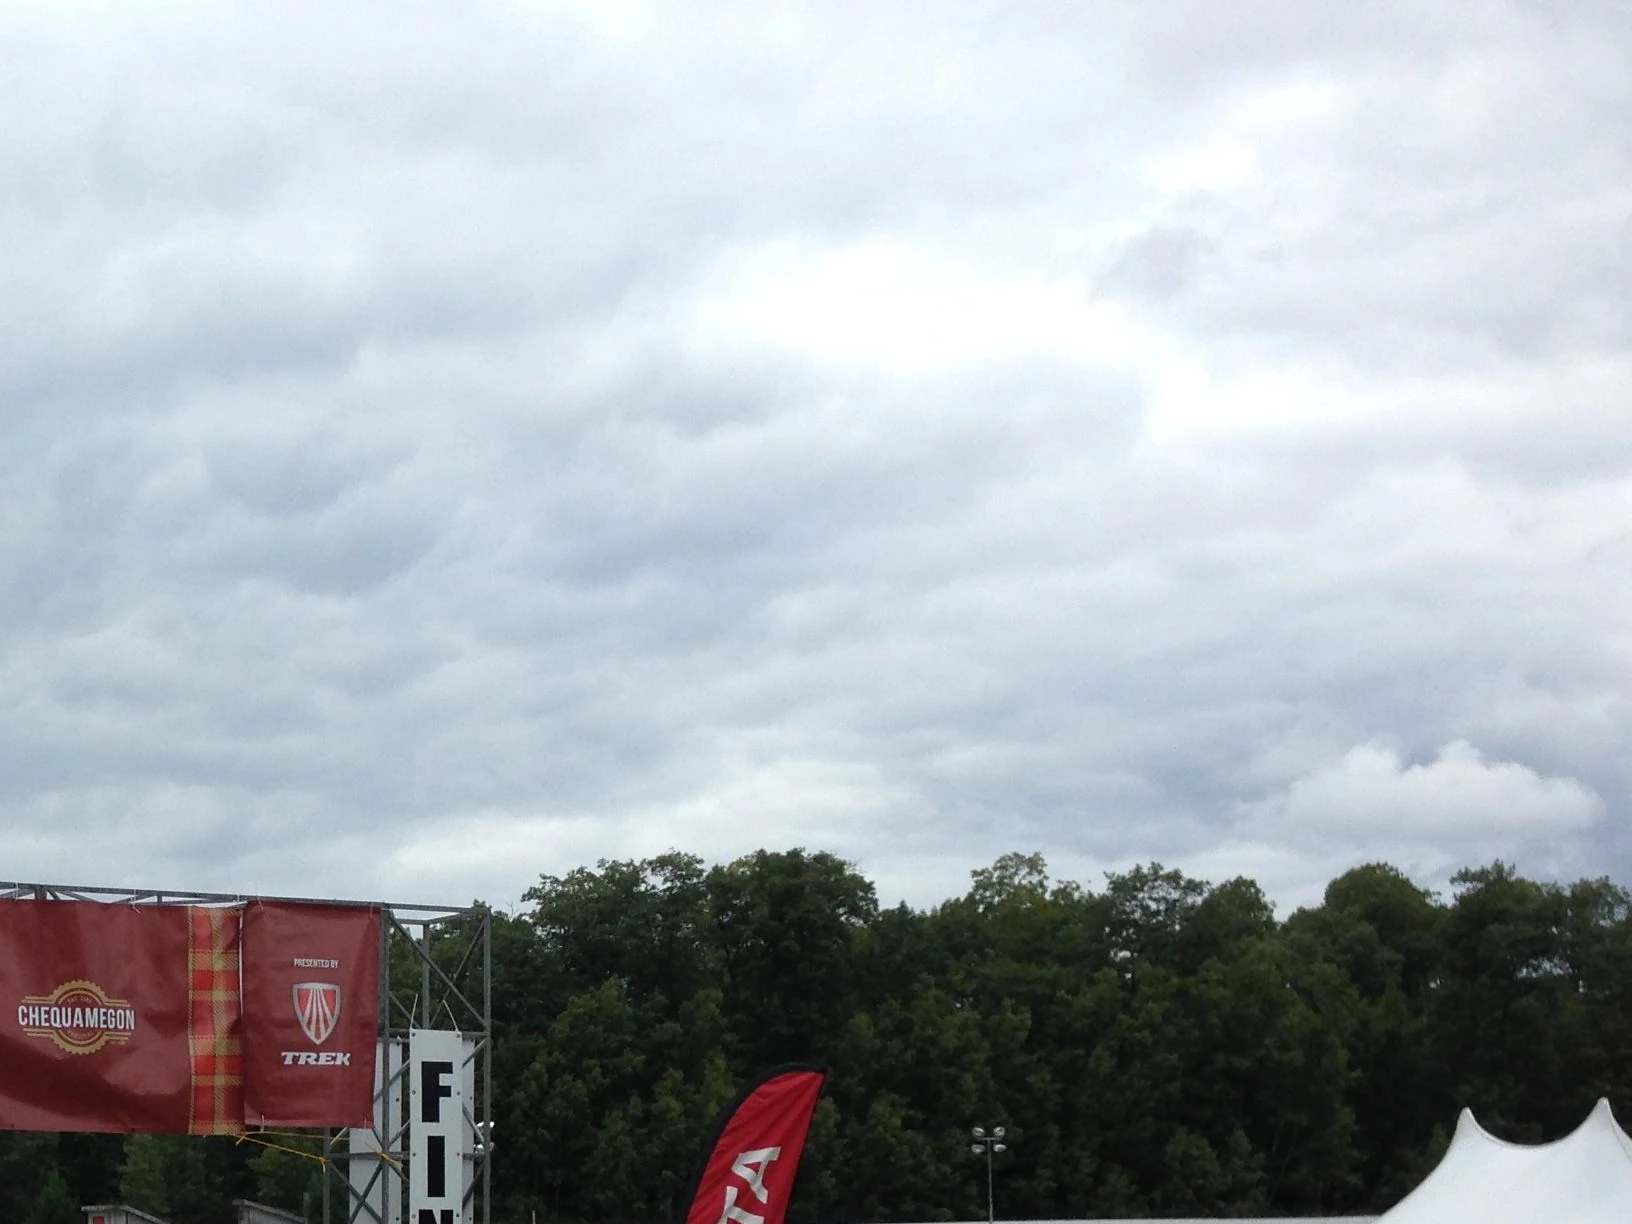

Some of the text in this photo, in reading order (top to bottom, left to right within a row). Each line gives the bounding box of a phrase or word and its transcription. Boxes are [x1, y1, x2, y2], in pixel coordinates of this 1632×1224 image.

[293, 958, 339, 969] PRESENTED BY
[18, 1005, 135, 1030] CHEQUAMEGON
[280, 1051, 351, 1067] TREK
